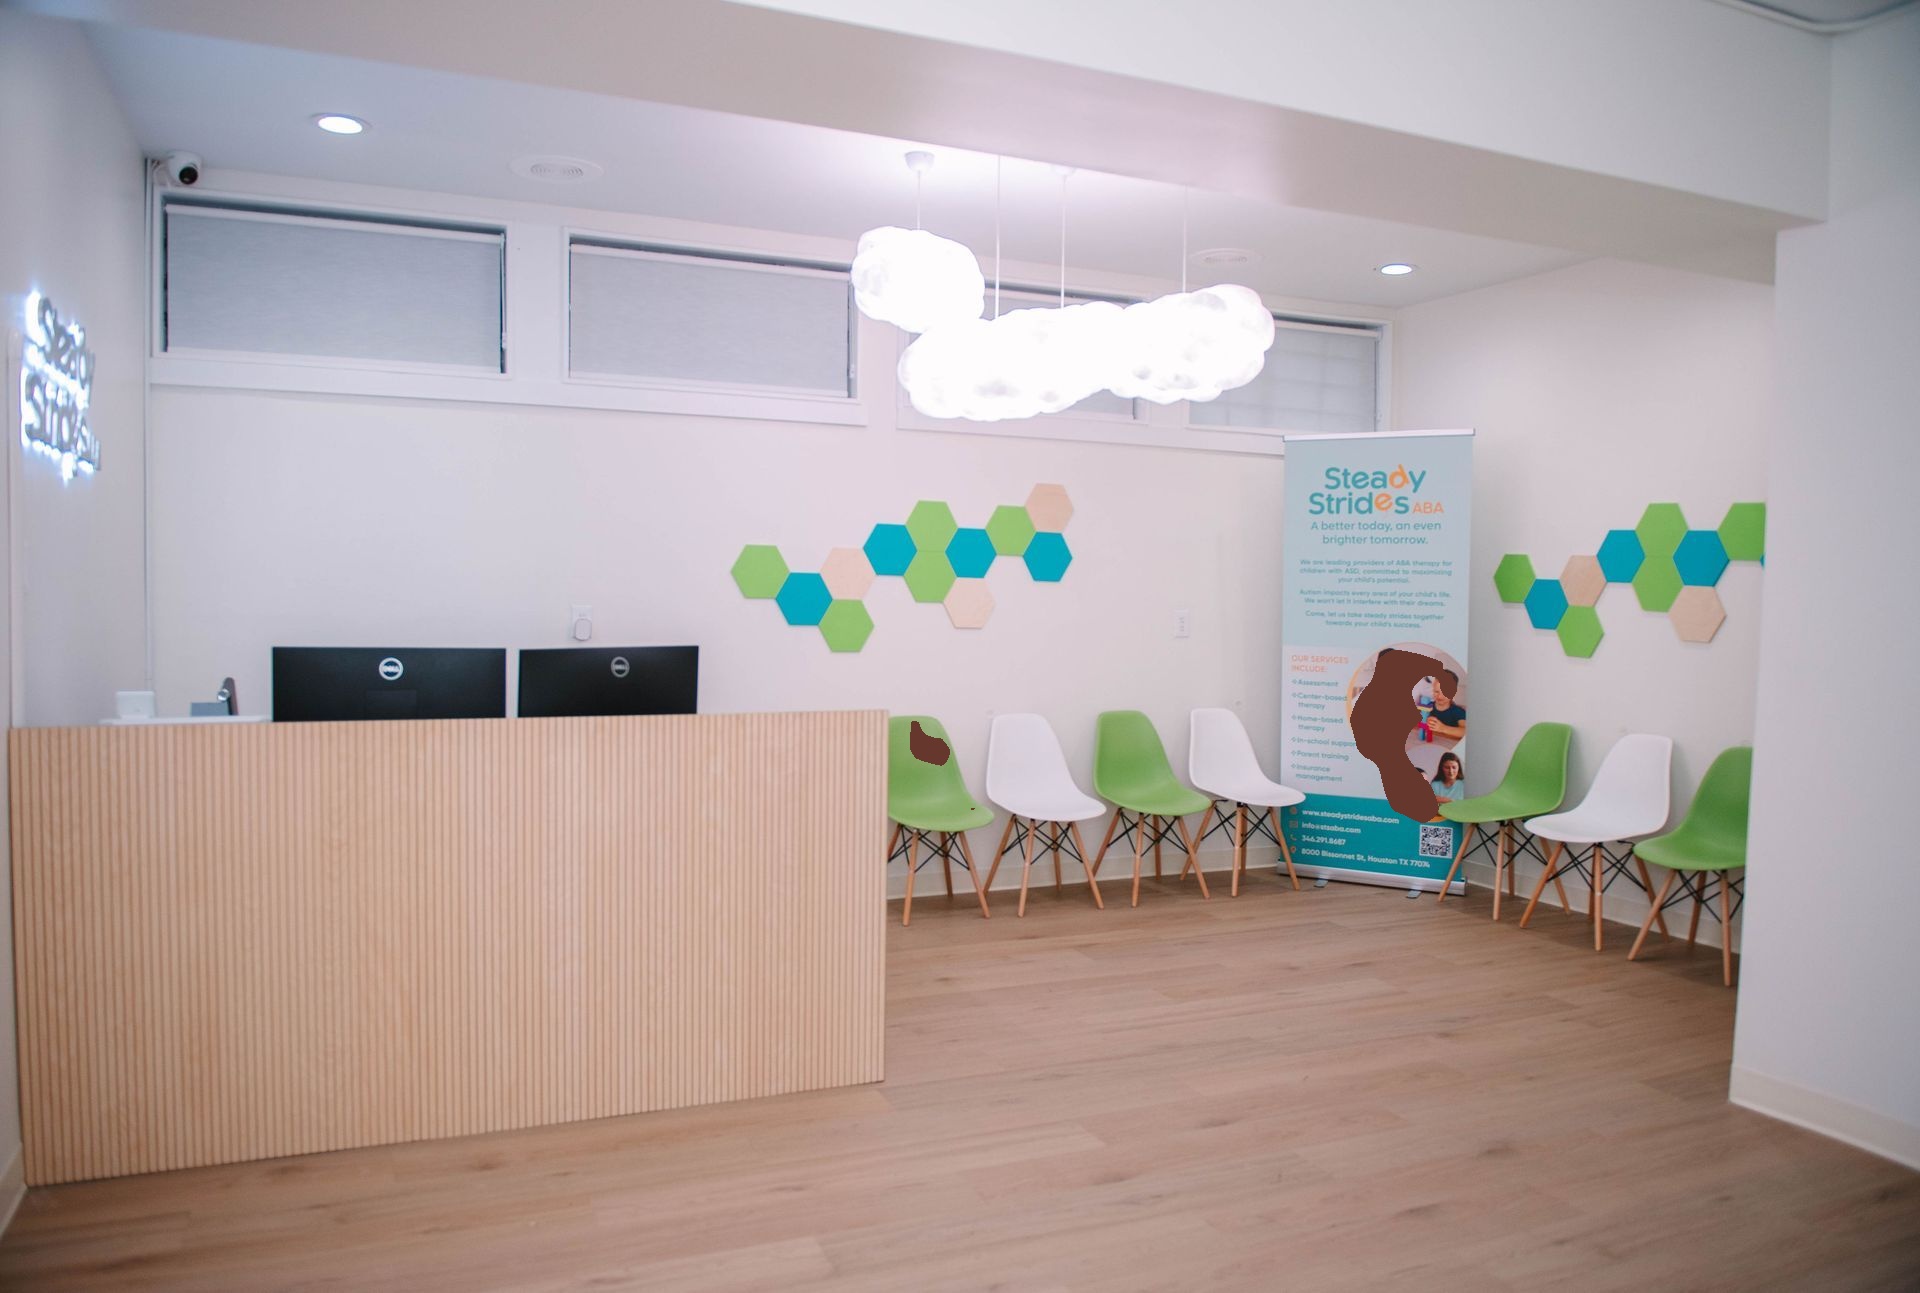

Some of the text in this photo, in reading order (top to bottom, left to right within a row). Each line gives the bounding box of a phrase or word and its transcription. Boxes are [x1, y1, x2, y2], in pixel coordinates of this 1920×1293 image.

[1324, 464, 1426, 493] Steady
[1308, 492, 1444, 515] Strides ABA
[1311, 521, 1319, 530] A
[1321, 521, 1354, 530] better
[1358, 521, 1393, 532] today,
[1413, 522, 1441, 530] even
[1322, 534, 1428, 546] brighter tomorrow.
[1311, 656, 1349, 664] SERVICES
[1298, 679, 1338, 687] Assessment
[1297, 692, 1348, 701] Center-based
[1298, 702, 1325, 710] therapy
[1297, 715, 1343, 724] Home-based
[1298, 724, 1325, 732] therapy
[1297, 750, 1349, 762] Parent training
[1296, 763, 1330, 772] Insurance
[1295, 773, 1343, 782] management
[1302, 809, 1399, 824] www.steadystridesaba.com
[1321, 850, 1355, 860] Bissonnet
[1368, 855, 1398, 865] Houston
[1399, 858, 1409, 866] TX
